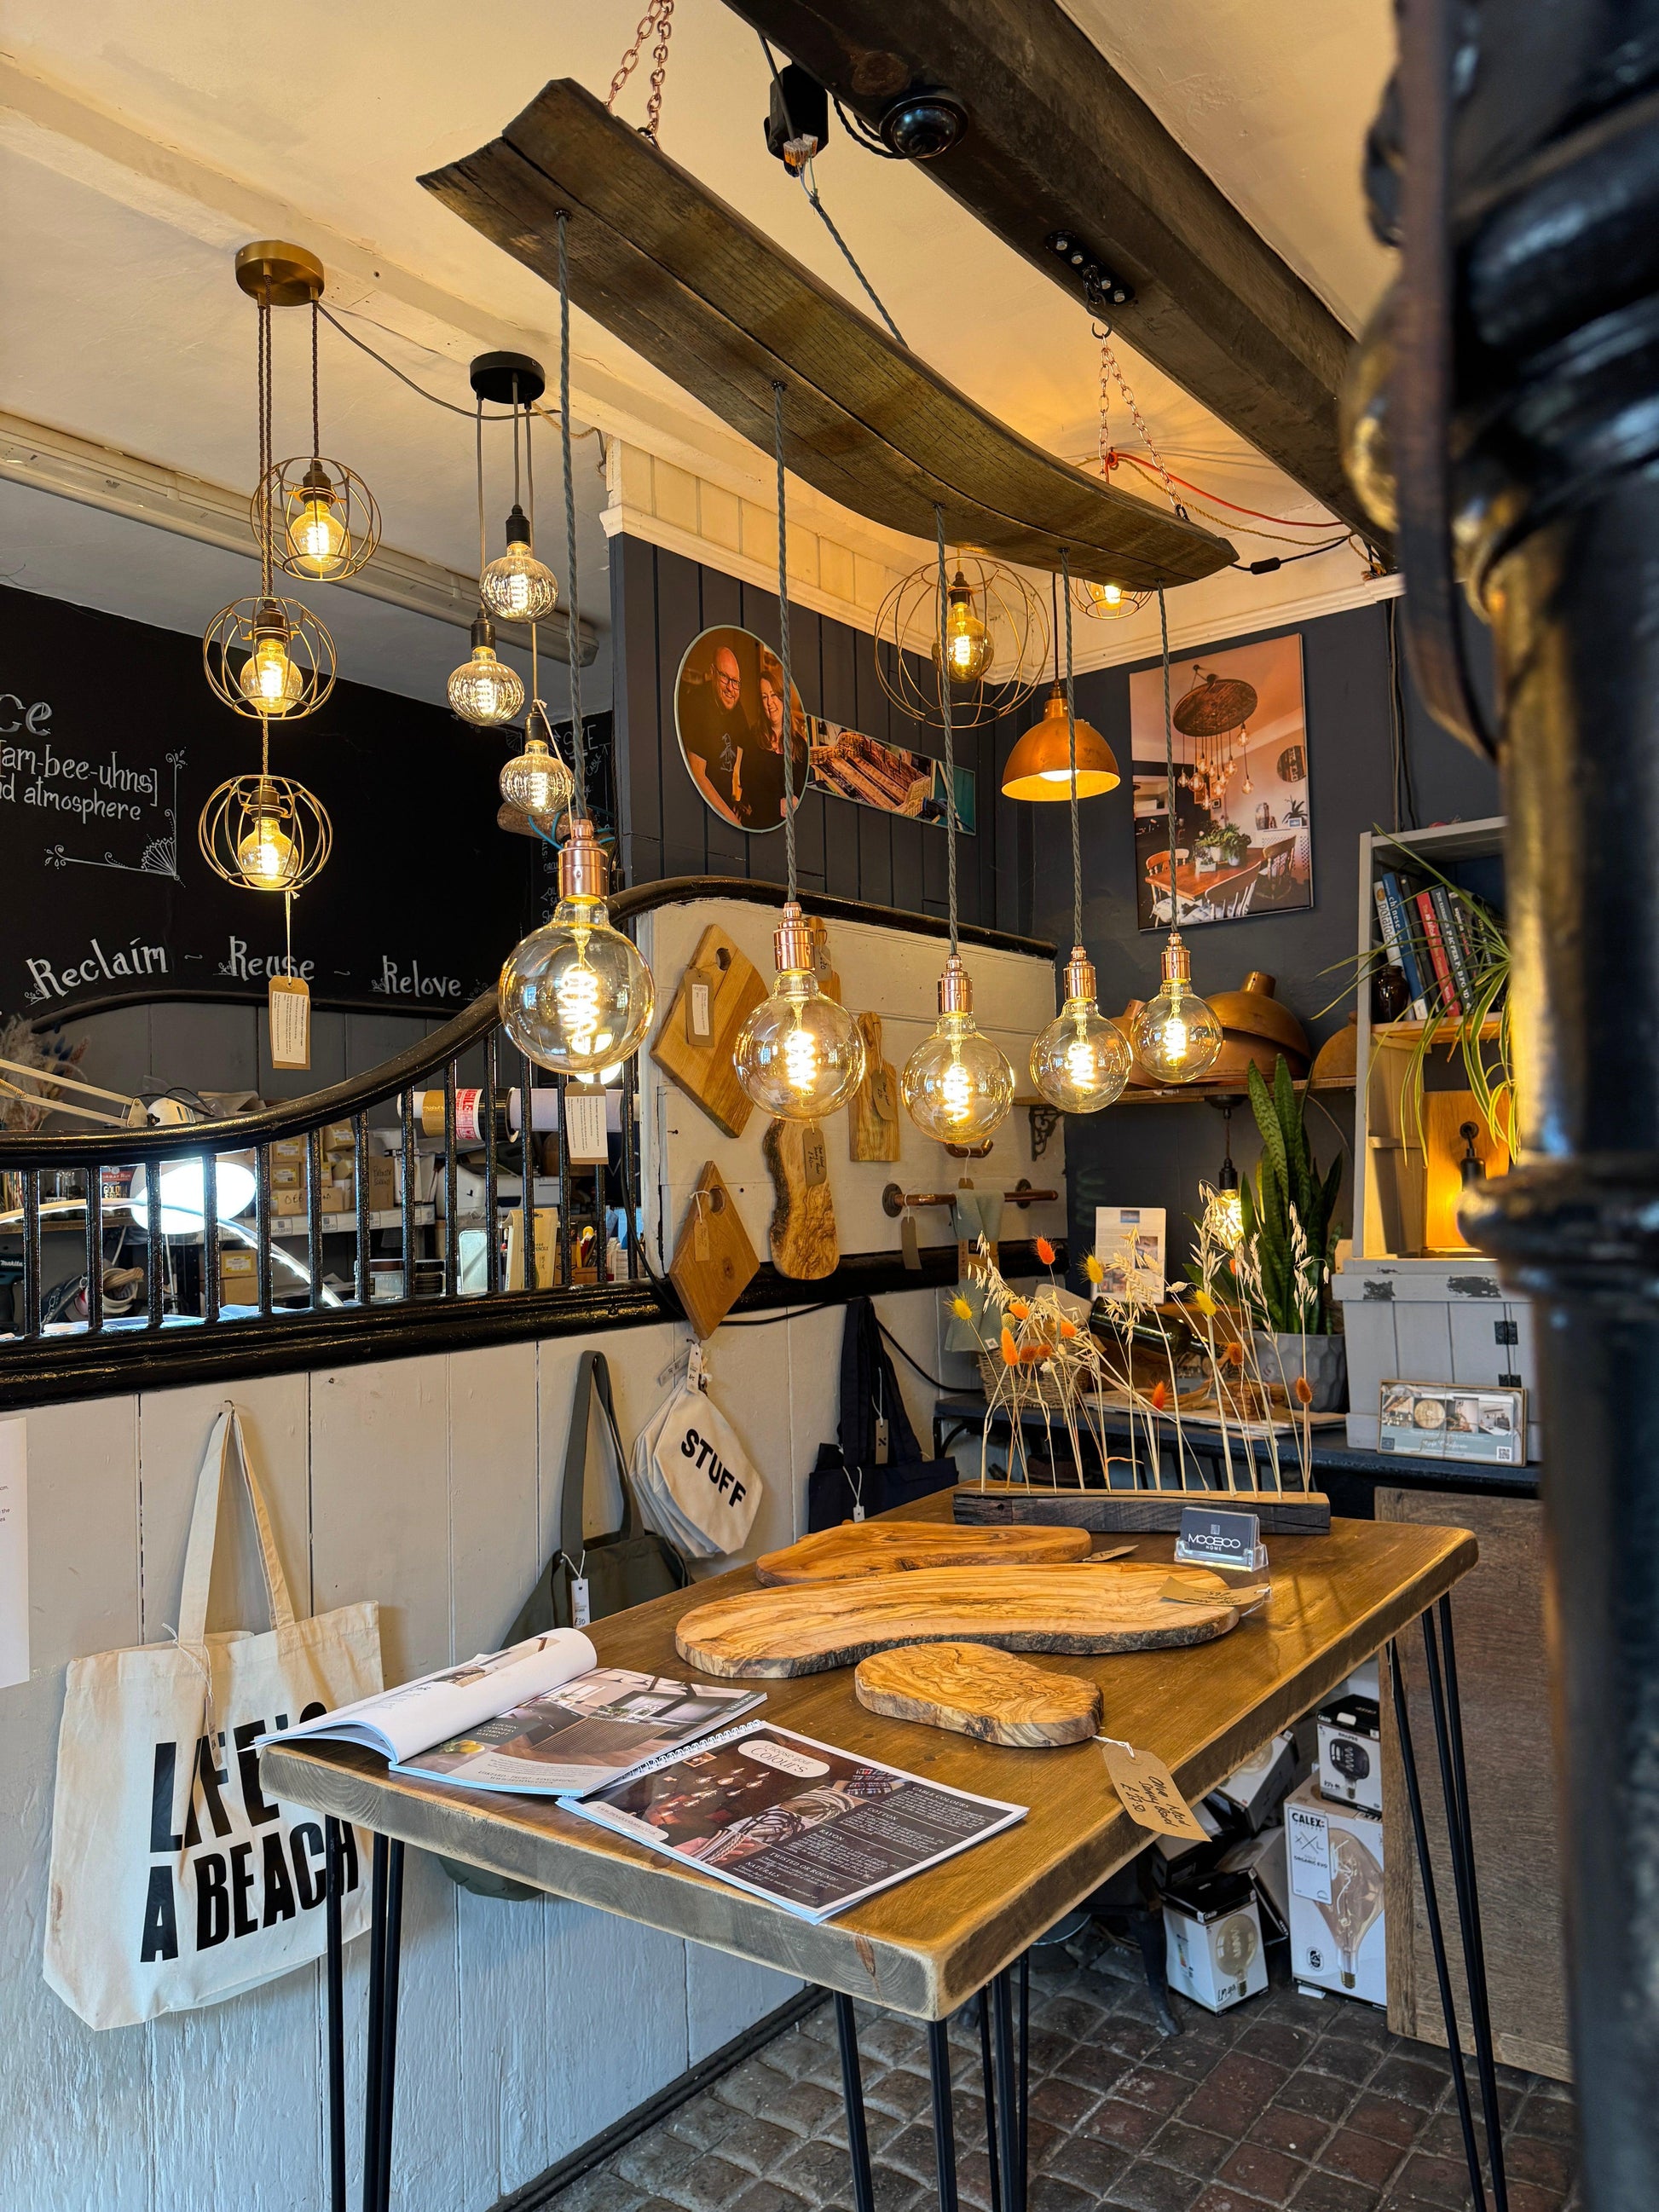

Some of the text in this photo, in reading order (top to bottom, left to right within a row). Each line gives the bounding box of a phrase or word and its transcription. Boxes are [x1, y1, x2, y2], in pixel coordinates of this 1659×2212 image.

[24, 777, 141, 824] atmosphere
[26, 935, 462, 1000] Reclaim Reuse Relove
[103, 1185, 122, 1194] GOLD
[680, 1428, 747, 1508] STUFF
[750, 1747, 808, 1773] Colours
[912, 1787, 970, 1808] CABLE COLOURS
[867, 1807, 899, 1821] COTTON
[1291, 1812, 1324, 1828] CALEX
[818, 1828, 845, 1841] RAYON
[745, 1861, 780, 1878] NATURALS
[770, 1851, 801, 1867] TWISTED
[800, 1863, 812, 1872] OR
[140, 1816, 360, 1963] A BEACH
